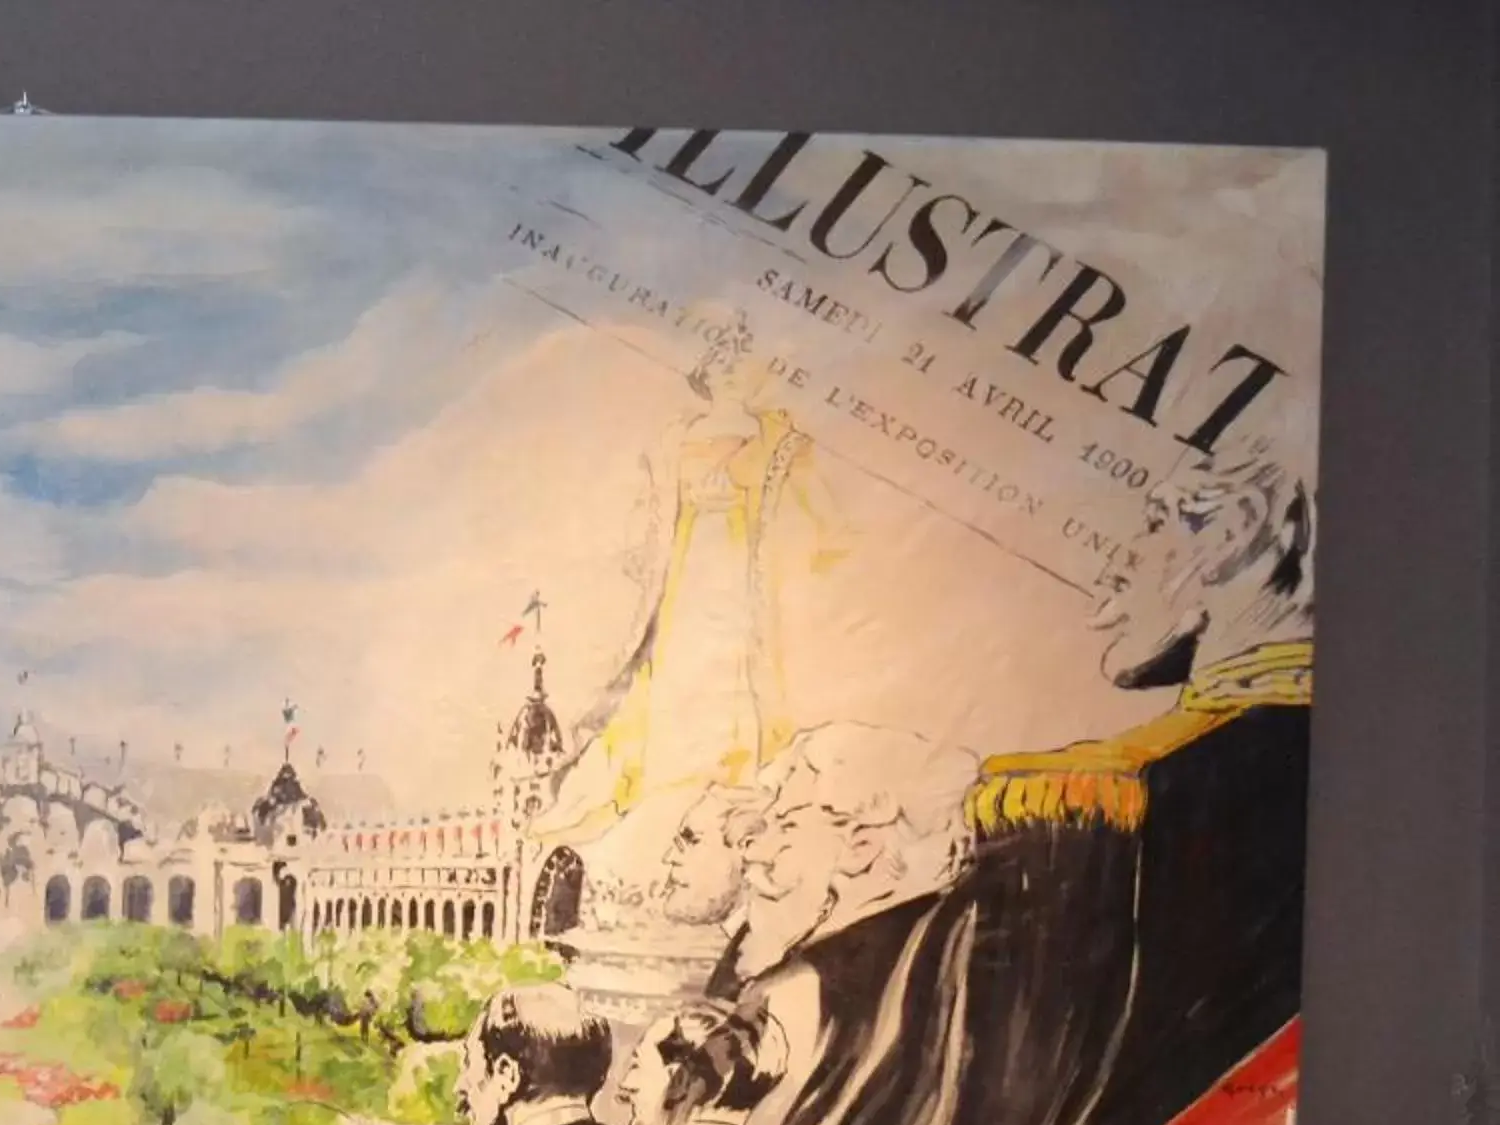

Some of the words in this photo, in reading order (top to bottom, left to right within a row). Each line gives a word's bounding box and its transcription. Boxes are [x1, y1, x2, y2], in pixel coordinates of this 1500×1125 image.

[755, 267, 884, 344] SAMEDI
[901, 339, 938, 375] 21
[954, 370, 1057, 444] AVRIL
[1077, 441, 1151, 490] 1900
[766, 355, 812, 389] DE
[823, 385, 1045, 516] L'EXPOSITION
